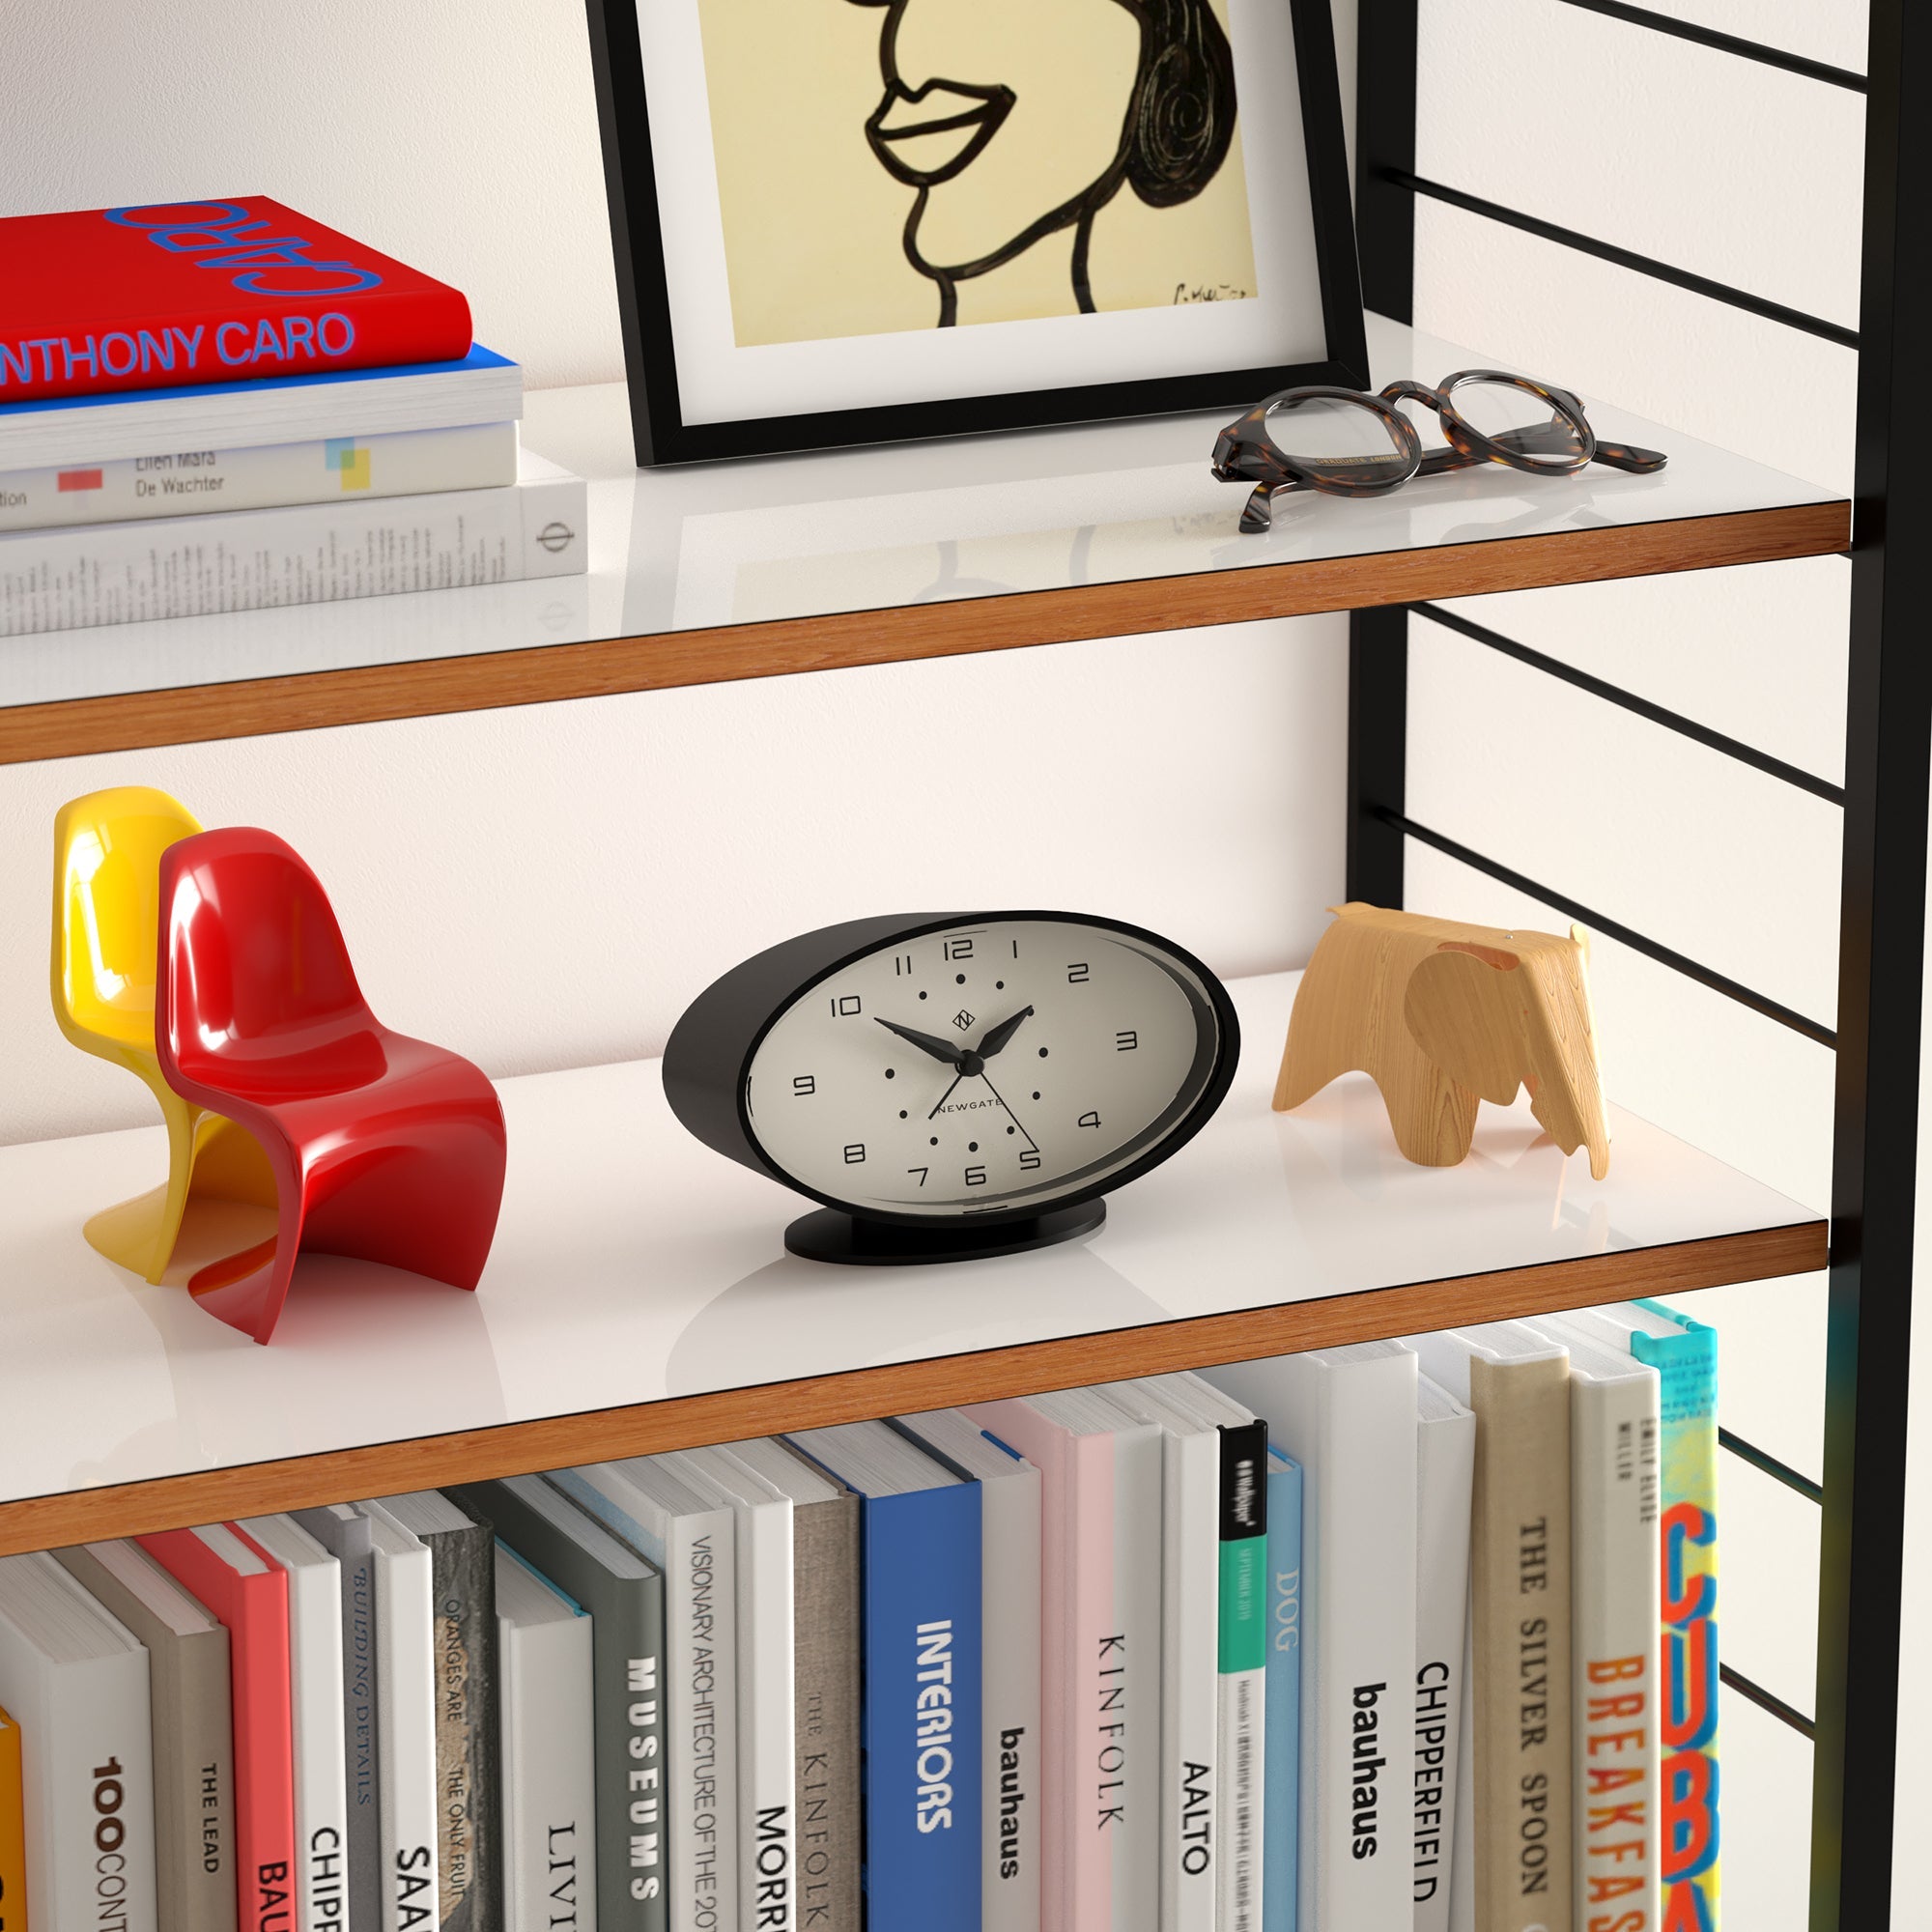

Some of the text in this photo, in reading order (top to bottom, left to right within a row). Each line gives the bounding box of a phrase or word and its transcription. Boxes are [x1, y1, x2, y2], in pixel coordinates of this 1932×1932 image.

[102, 200, 384, 297] CARO
[216, 312, 356, 365] CARO
[135, 476, 224, 497] De Wachter
[895, 955, 912, 976] 11
[944, 940, 973, 961] 12
[1012, 940, 1018, 959] 1
[1066, 963, 1090, 983] 2
[831, 995, 862, 1017] 10
[1115, 1031, 1138, 1051] 3
[793, 1075, 815, 1095] 9
[937, 1098, 1004, 1114] NEWGATE
[1077, 1111, 1101, 1129] 4
[843, 1144, 866, 1164] 8
[907, 1167, 929, 1186] 7
[965, 1166, 987, 1186] 6
[1019, 1151, 1041, 1171] 5
[1520, 1517, 1547, 1595] THE
[1275, 1567, 1299, 1653] DOG
[352, 1567, 372, 1806] BUILDING DETAILS
[444, 1599, 463, 1722] ORANGES ARE
[1520, 1618, 1547, 1750] SILVER
[691, 1534, 718, 1932] VISIONARY ARCHITECTURE OF THE 20
[807, 1691, 822, 1738] THE
[916, 1619, 953, 1833] INTERIORS
[1098, 1634, 1125, 1831] KINFOLK
[627, 1655, 660, 1901] MUSEUMS
[1000, 1726, 1025, 1881] bauhaus
[1352, 1682, 1387, 1861] bauhaus
[201, 1762, 220, 1874] THE LEAD
[447, 1768, 466, 1898] THE ONLY FRUIT
[805, 1752, 829, 1925] KINFOLK
[1181, 1760, 1211, 1876] AALTO
[1520, 1772, 1548, 1898] SPOON
[397, 1845, 433, 1932] SAA
[548, 1821, 577, 1932] LIVI
[755, 1805, 788, 1932] MORR
